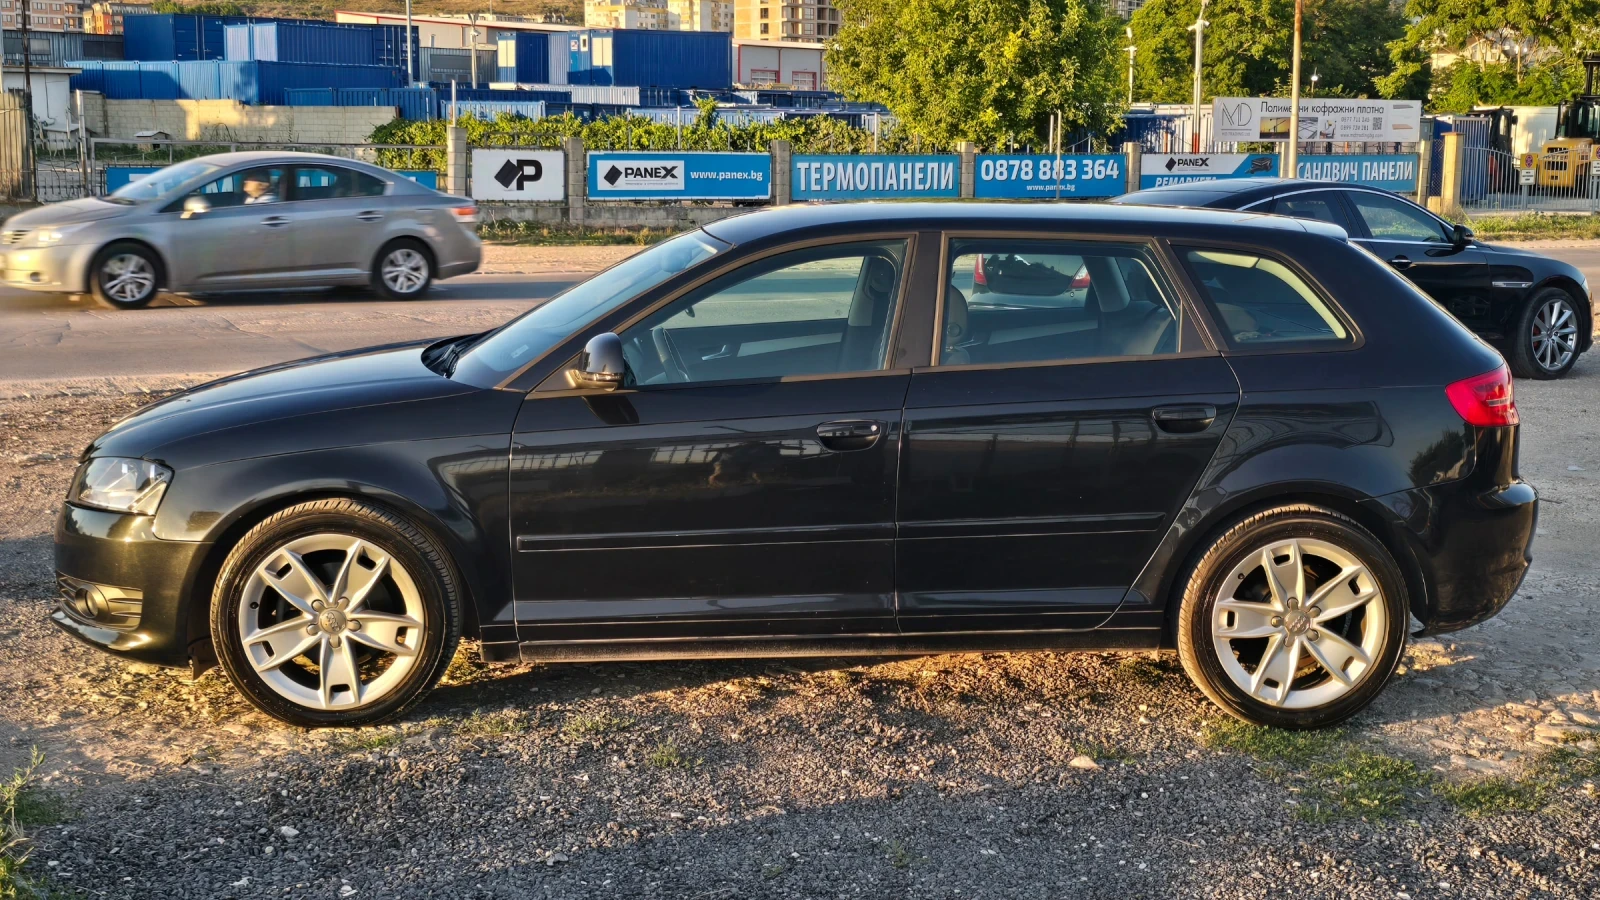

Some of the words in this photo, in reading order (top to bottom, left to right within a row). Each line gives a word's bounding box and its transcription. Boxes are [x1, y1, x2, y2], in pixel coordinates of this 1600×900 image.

[1261, 101, 1309, 113] Полимени
[1311, 102, 1355, 116] кофражни
[981, 160, 1033, 181] 0878
[1039, 160, 1077, 180] 883
[1082, 159, 1119, 179] 364
[1177, 158, 1209, 167] PANEX
[624, 166, 678, 179] PANEX
[690, 169, 763, 181] www.panex.bg
[797, 162, 954, 191] ТЕРМОПАНЕЛИ
[1362, 161, 1413, 181] ПАНЕЛИ
